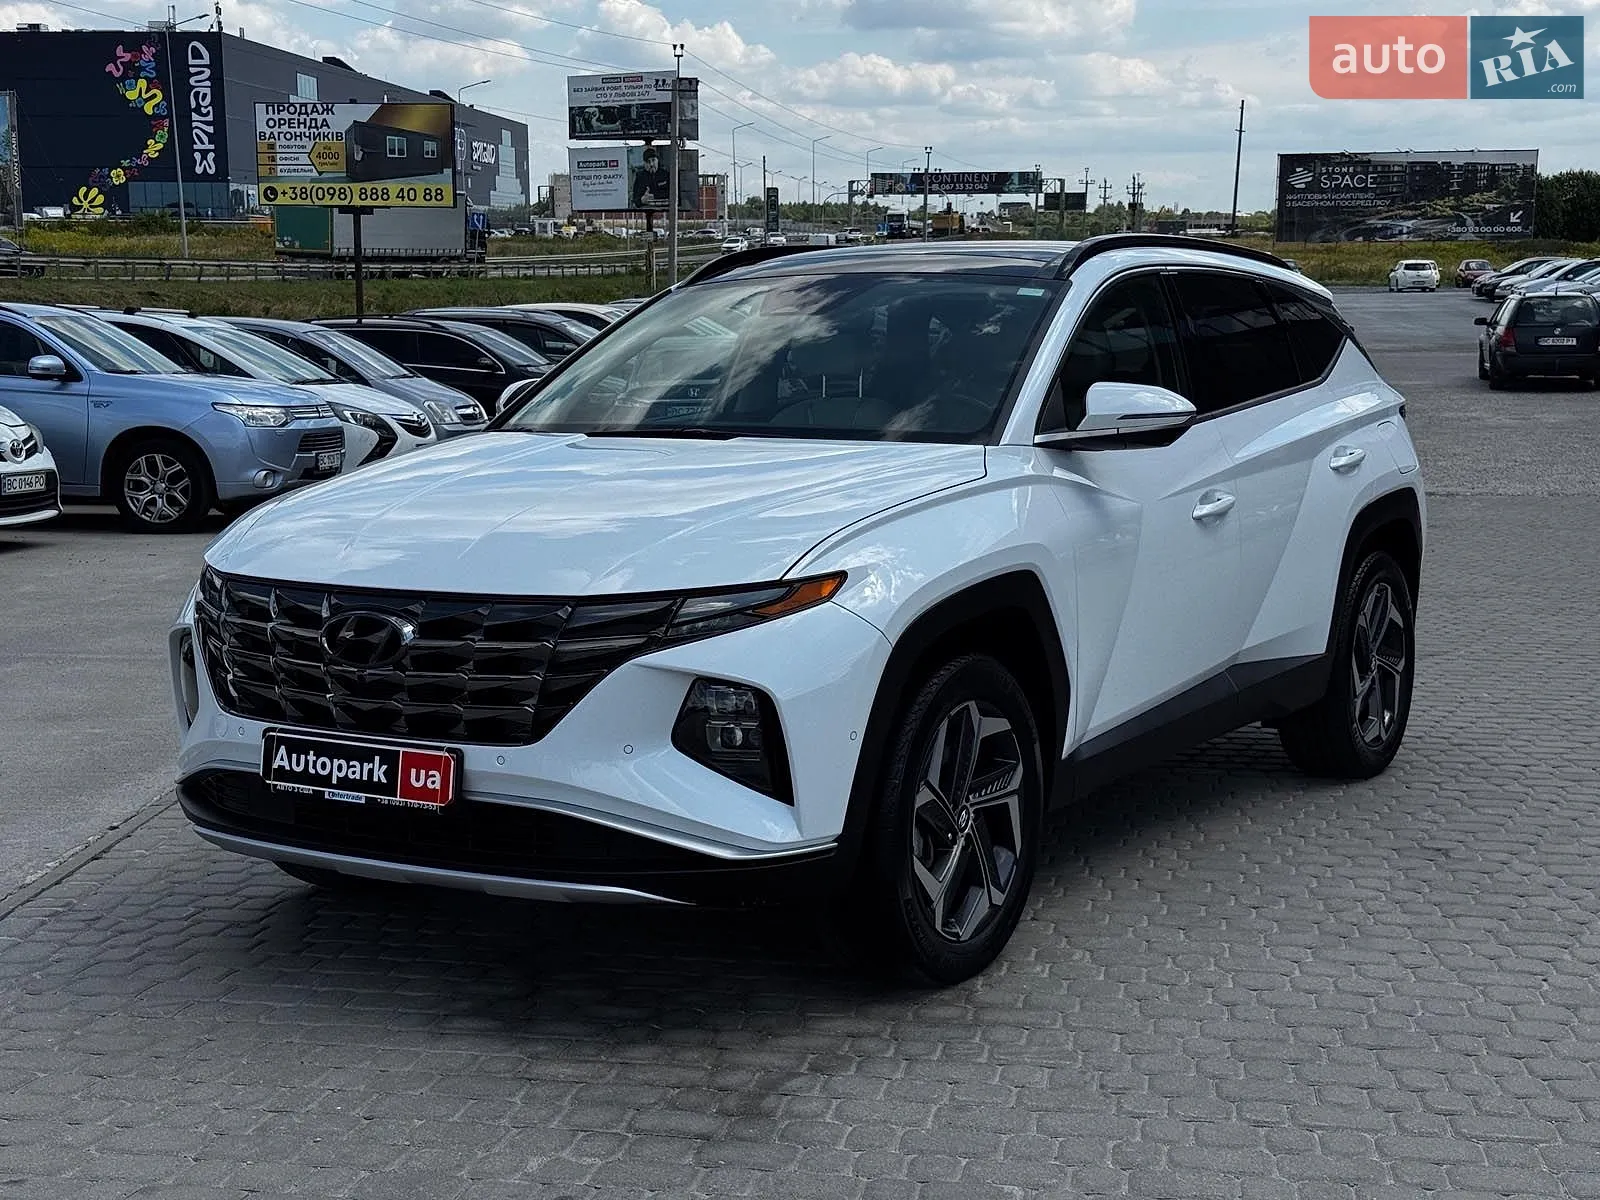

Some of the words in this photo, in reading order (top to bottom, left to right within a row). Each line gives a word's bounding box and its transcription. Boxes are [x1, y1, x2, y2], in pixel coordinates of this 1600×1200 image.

[265, 104, 336, 117] ПРОДАЖ
[265, 117, 331, 131] ОРЕНДА
[258, 131, 344, 141] ВАГОНЧИКІВ
[315, 151, 340, 161] 4000
[922, 173, 998, 183] CONTINENT
[1320, 174, 1378, 188] SPACE
[280, 185, 353, 205] +38(098)
[358, 187, 390, 202] 888
[395, 187, 417, 202] 40
[422, 187, 444, 202] 88
[7, 479, 17, 490] BC
[34, 475, 44, 488] PO
[273, 745, 388, 784] Autopark
[410, 767, 441, 790] ua
